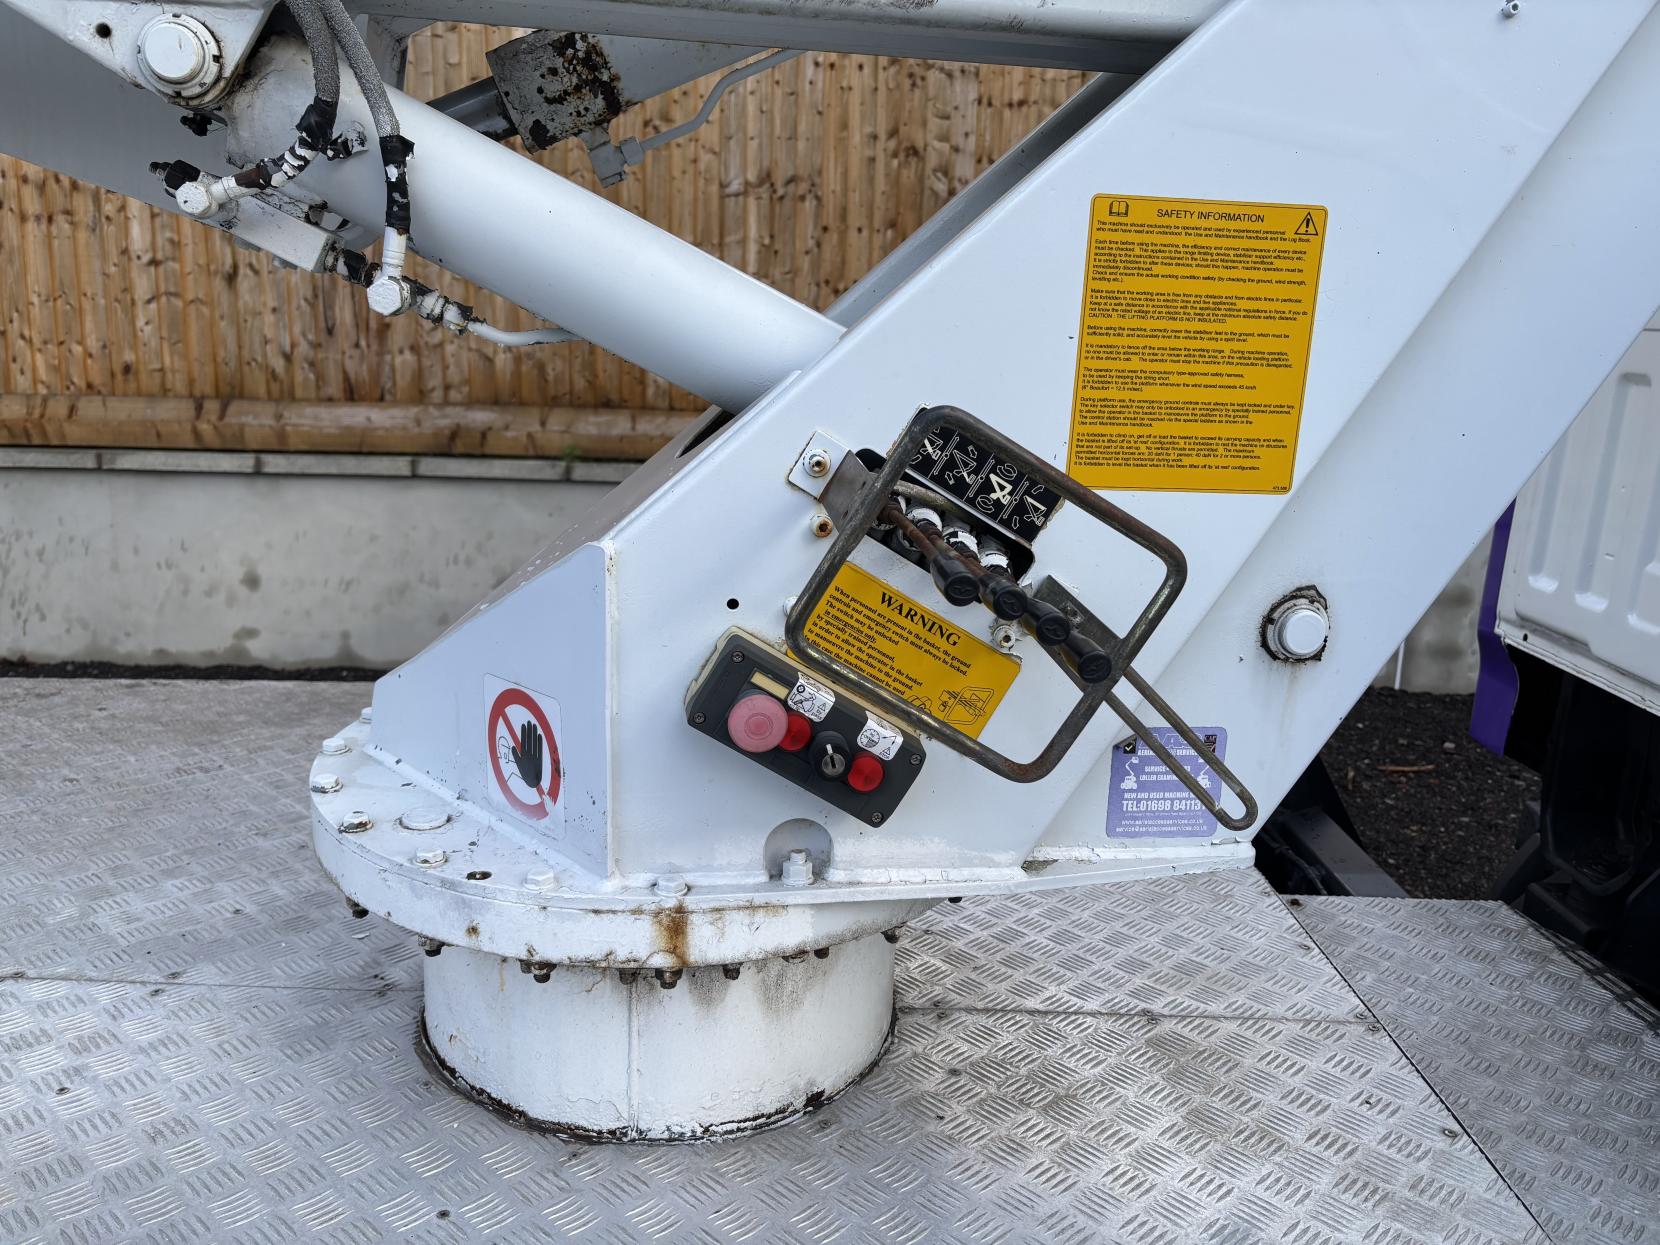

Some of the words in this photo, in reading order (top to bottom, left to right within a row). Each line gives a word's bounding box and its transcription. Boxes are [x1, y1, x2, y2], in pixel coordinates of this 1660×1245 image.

[1156, 208, 1195, 220] SAFETY
[1197, 210, 1265, 223] INFORMATION
[824, 619, 847, 635] specially
[848, 632, 868, 646] trained
[825, 599, 836, 609] The
[837, 607, 854, 620] switch
[854, 618, 867, 627] may
[874, 629, 899, 645] unlocked
[829, 614, 864, 636] emergencies
[829, 594, 851, 609] controls
[851, 607, 863, 615] and
[862, 613, 892, 632] emergency
[892, 630, 909, 642] switch
[909, 640, 924, 650] must
[923, 648, 941, 661] always
[835, 586, 850, 599] When
[849, 597, 877, 614] personnel
[877, 612, 886, 620] are
[885, 618, 907, 632] present
[913, 633, 922, 641] the
[942, 649, 951, 657] the
[950, 655, 971, 669] ground
[881, 592, 961, 646] WARNING
[810, 639, 821, 648] this
[821, 646, 833, 655] case
[833, 652, 843, 660] the
[843, 658, 866, 673] machine
[866, 671, 885, 684] cannot
[892, 686, 905, 696] used
[818, 625, 835, 636] order
[841, 638, 856, 648] allow
[856, 646, 865, 654] the
[865, 652, 889, 667] operator
[904, 673, 923, 687] basket
[854, 655, 877, 669] machine
[1122, 799, 1171, 811] TEL:01698
